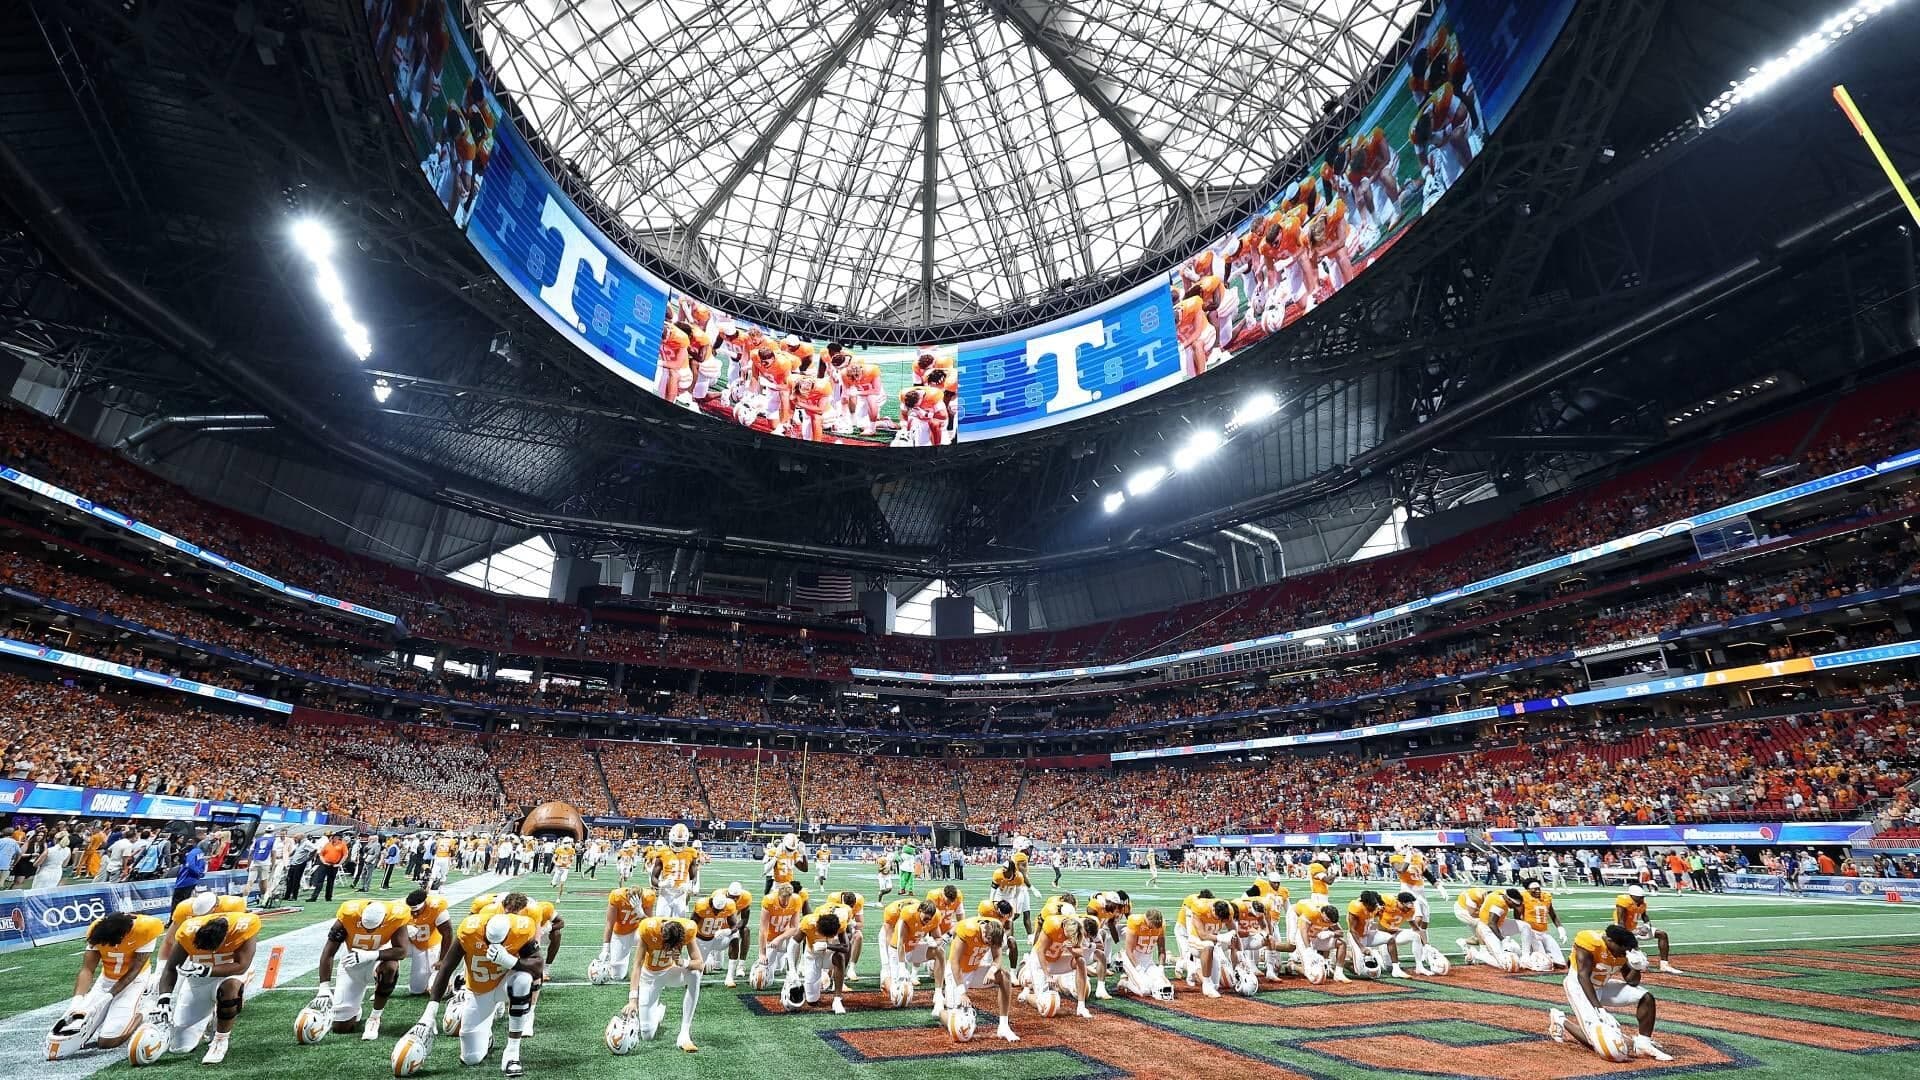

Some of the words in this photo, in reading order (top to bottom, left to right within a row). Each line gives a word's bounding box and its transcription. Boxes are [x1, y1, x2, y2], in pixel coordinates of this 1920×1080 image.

[540, 193, 607, 328] T
[1140, 305, 1159, 333] S
[624, 324, 646, 358] T
[1138, 340, 1162, 370] T
[1026, 320, 1105, 413] T
[981, 392, 1004, 416] T
[1573, 642, 1626, 658] Mercedes-Benz
[1627, 635, 1659, 648] Stadium
[1764, 661, 1785, 676] T
[90, 793, 131, 813] ORANGE
[709, 820, 727, 830] 2:26
[1727, 880, 1751, 891] Georgia
[1752, 881, 1775, 890] Power
[1887, 892, 1897, 902] 10
[43, 898, 106, 926] oobē
[352, 934, 383, 950] 51
[107, 952, 124, 974] 7
[651, 950, 673, 967] 15
